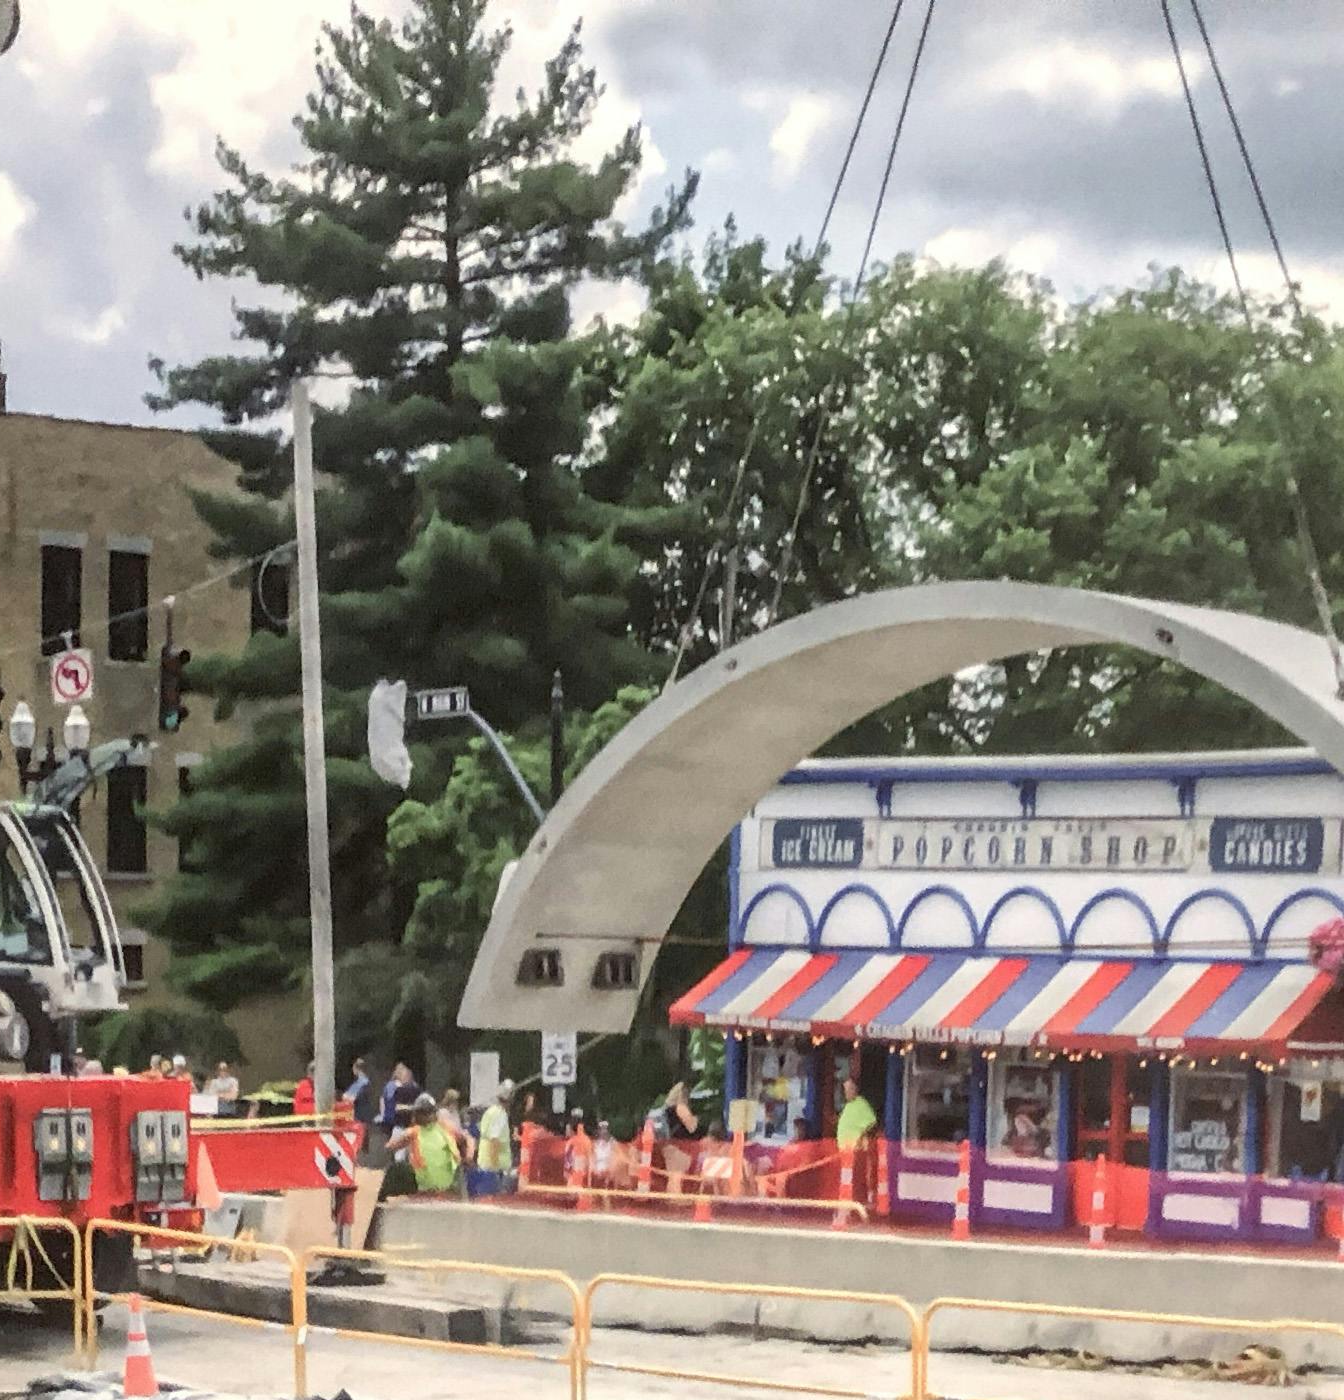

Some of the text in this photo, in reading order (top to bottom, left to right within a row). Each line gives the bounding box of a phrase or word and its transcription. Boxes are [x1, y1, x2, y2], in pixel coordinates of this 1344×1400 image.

[781, 839, 855, 863] ICE CREAM
[892, 836, 1177, 866] POPCORN SHOP
[1223, 840, 1308, 866] CANDIES
[544, 1053, 573, 1077] 25
